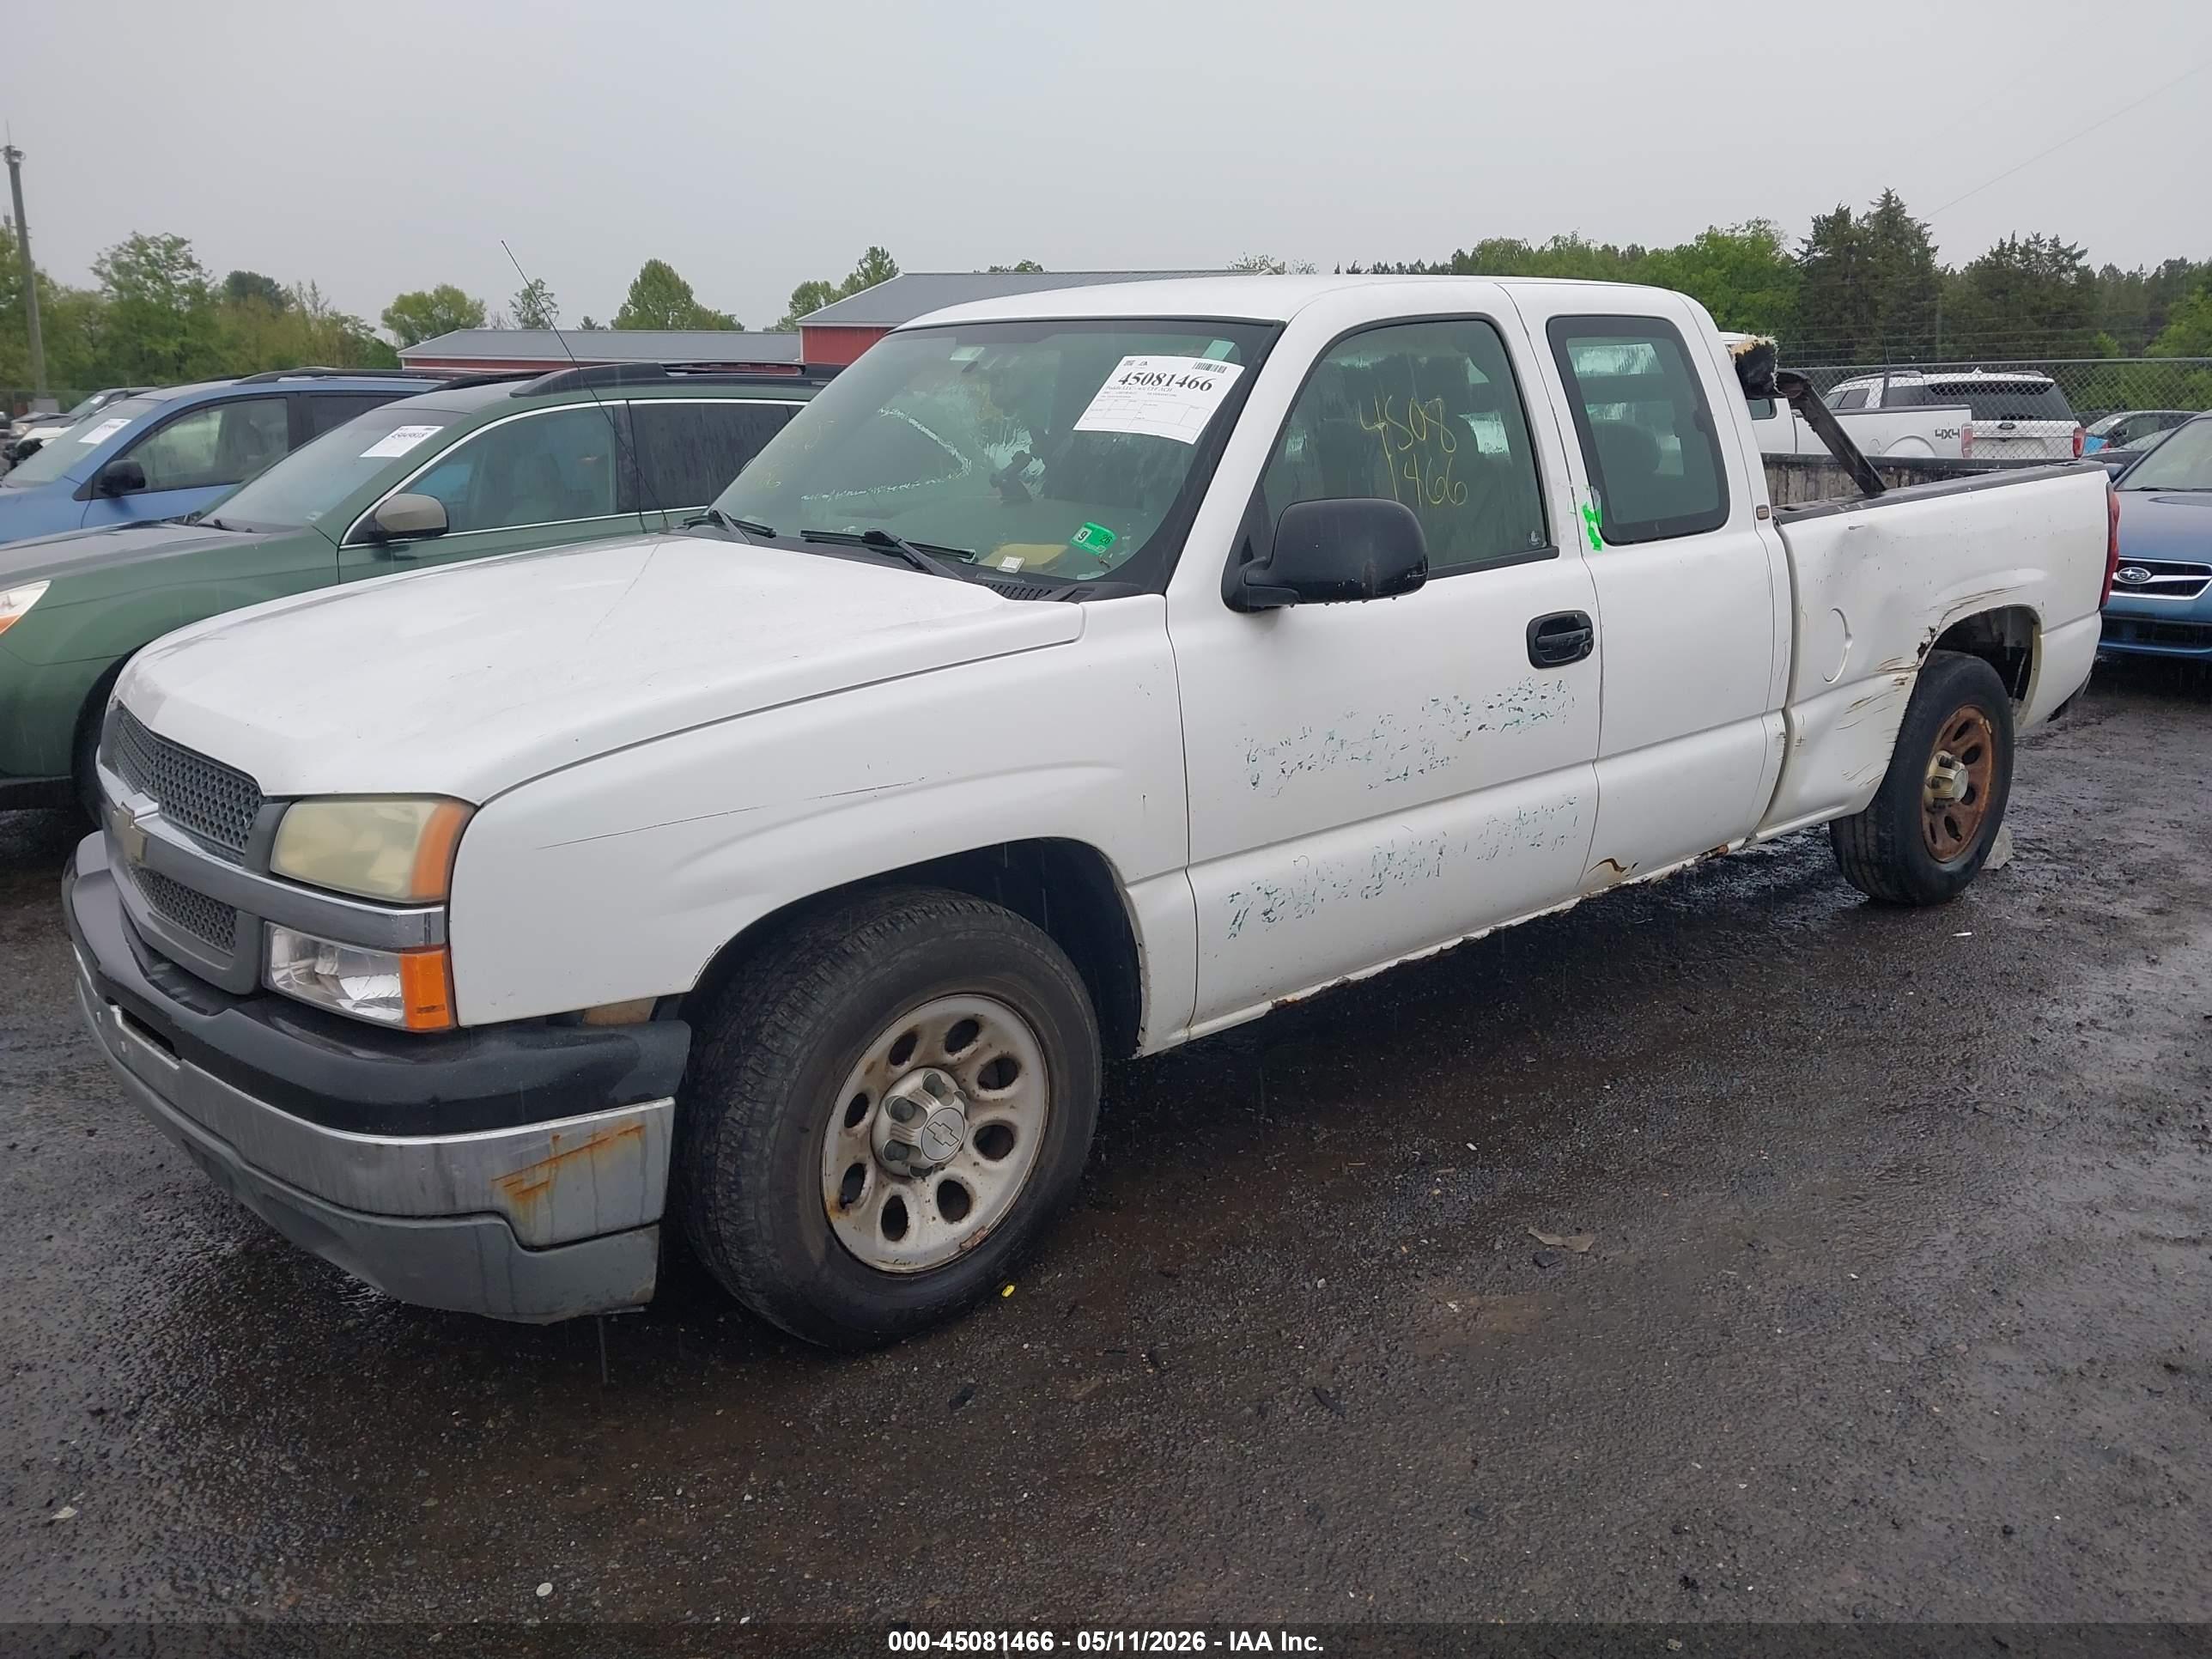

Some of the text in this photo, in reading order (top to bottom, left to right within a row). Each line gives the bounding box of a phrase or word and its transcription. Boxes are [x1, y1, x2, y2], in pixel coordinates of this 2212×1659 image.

[1118, 371, 1216, 392] 45081466
[1358, 394, 1457, 454] 4508
[1387, 453, 1468, 507] 1466
[1078, 531, 1114, 544] 9 26
